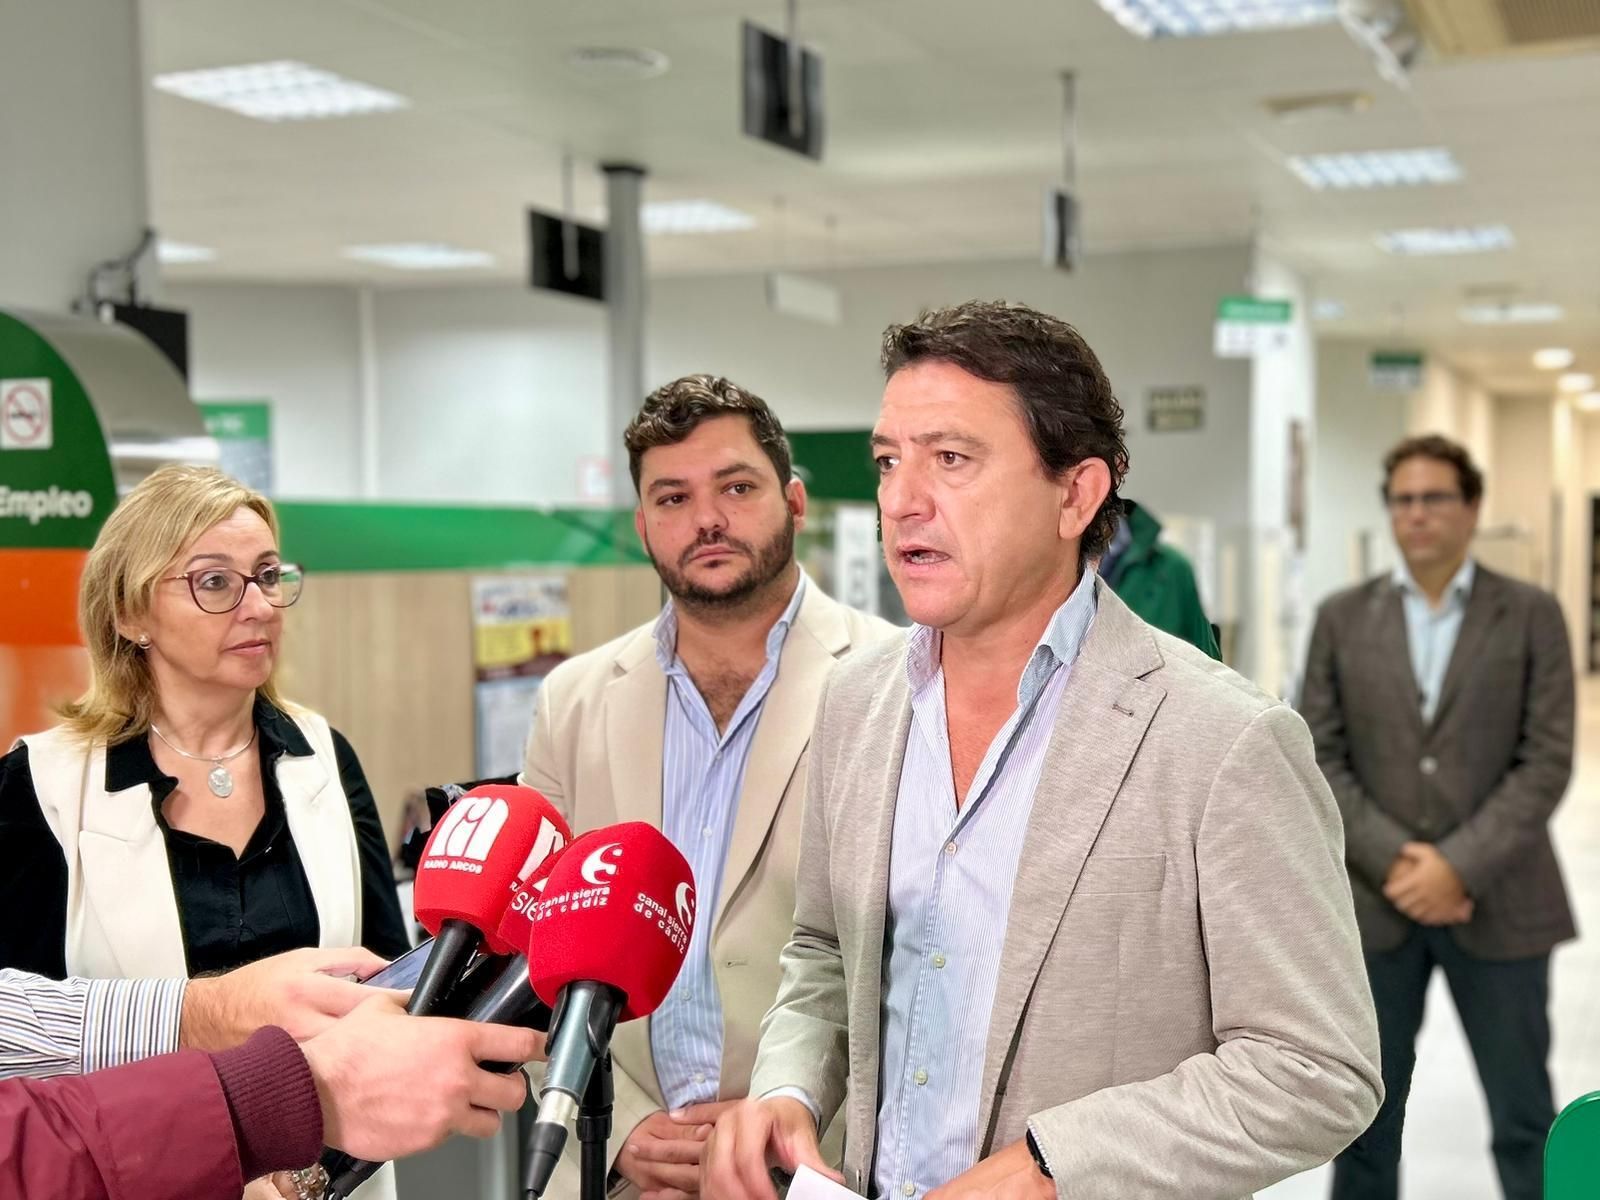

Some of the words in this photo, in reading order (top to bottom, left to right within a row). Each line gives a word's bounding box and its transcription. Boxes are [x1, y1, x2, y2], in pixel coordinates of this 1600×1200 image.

[0, 485, 93, 525] Empleo
[424, 860, 449, 870] RADIO
[449, 861, 483, 875] ARCOS
[539, 892, 570, 910] canal
[572, 886, 610, 900] sierra
[633, 902, 653, 919] de
[637, 892, 667, 918] canal
[667, 915, 687, 944] sierra
